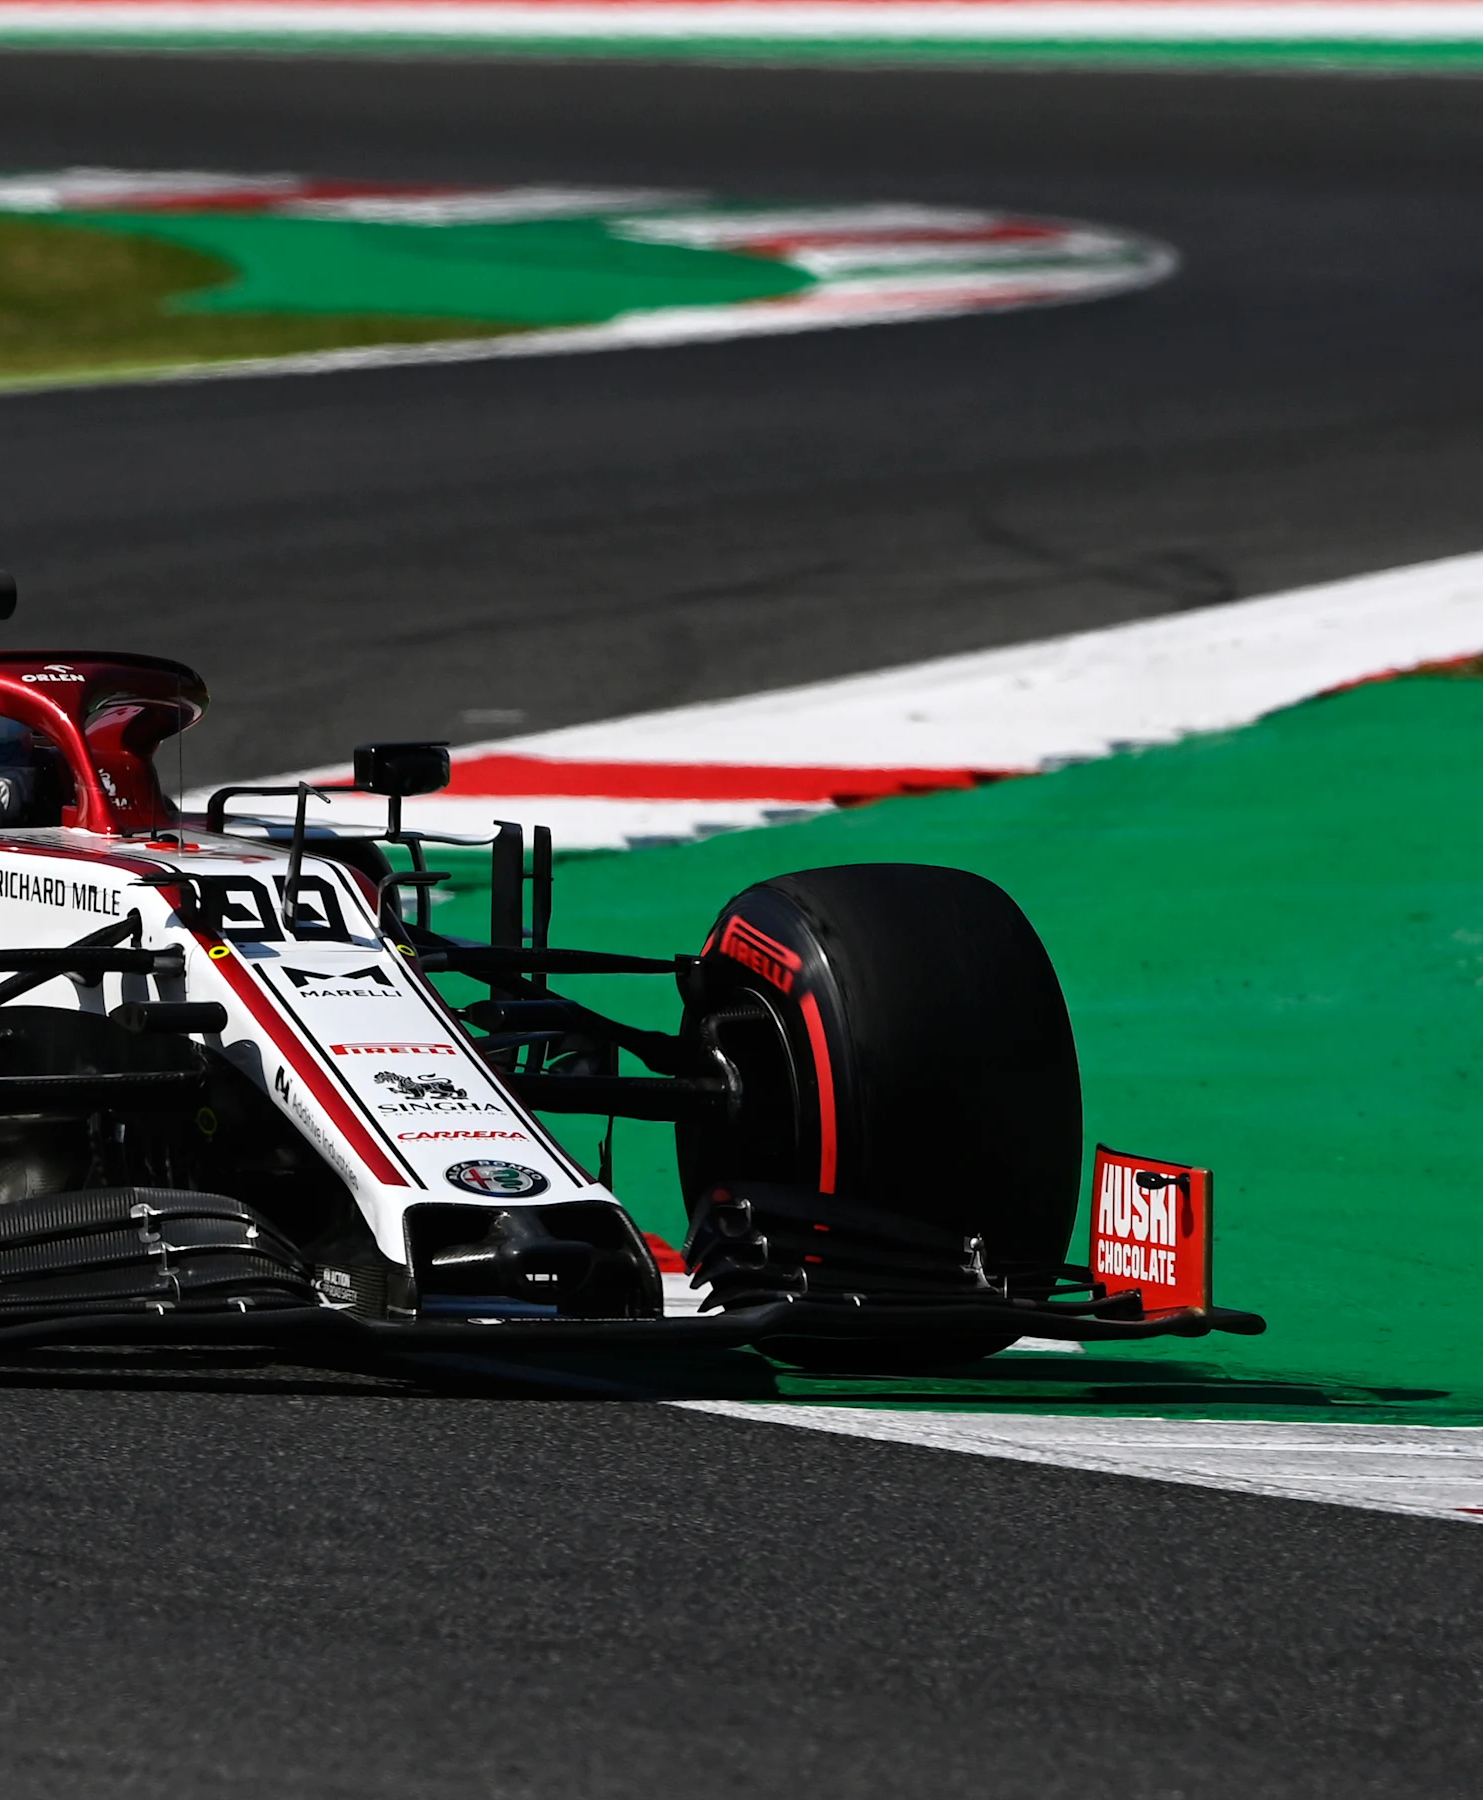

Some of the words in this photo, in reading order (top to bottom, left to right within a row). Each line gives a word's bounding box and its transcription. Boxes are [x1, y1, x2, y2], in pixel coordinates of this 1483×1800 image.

[21, 673, 85, 683] ORLEN
[72, 881, 122, 916] MILLE
[206, 875, 353, 942] 99
[720, 914, 803, 995] PIRELLI
[300, 989, 403, 998] MARELLI
[329, 1042, 457, 1056] PIRELLI
[378, 1102, 503, 1114] SINGHA
[397, 1130, 528, 1141] CARRERA
[449, 1162, 472, 1181] ALFA
[478, 1160, 543, 1181] ROMEO
[1097, 1162, 1177, 1247] HUSKI
[1097, 1239, 1177, 1286] CHOCOLATE
